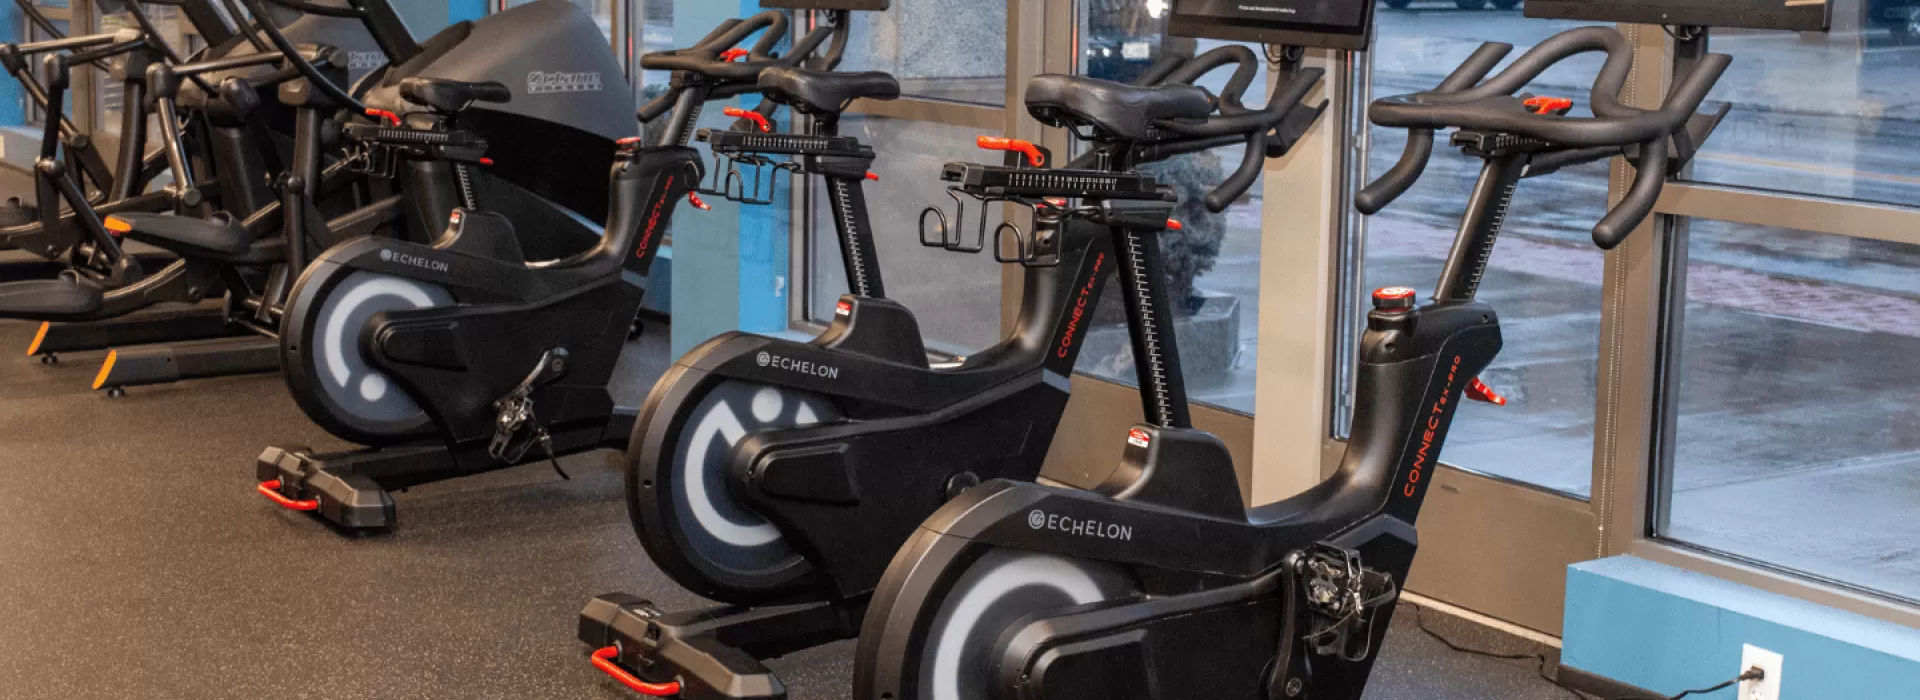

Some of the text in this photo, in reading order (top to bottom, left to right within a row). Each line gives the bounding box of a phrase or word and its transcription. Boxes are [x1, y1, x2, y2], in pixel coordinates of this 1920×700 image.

[636, 202, 662, 258] CONNECT
[392, 252, 449, 272] ECHELON
[1057, 287, 1090, 358] CONNECT
[771, 355, 838, 379] ECHELON
[1404, 402, 1443, 497] CONNECT
[1047, 514, 1132, 541] ECHELON
